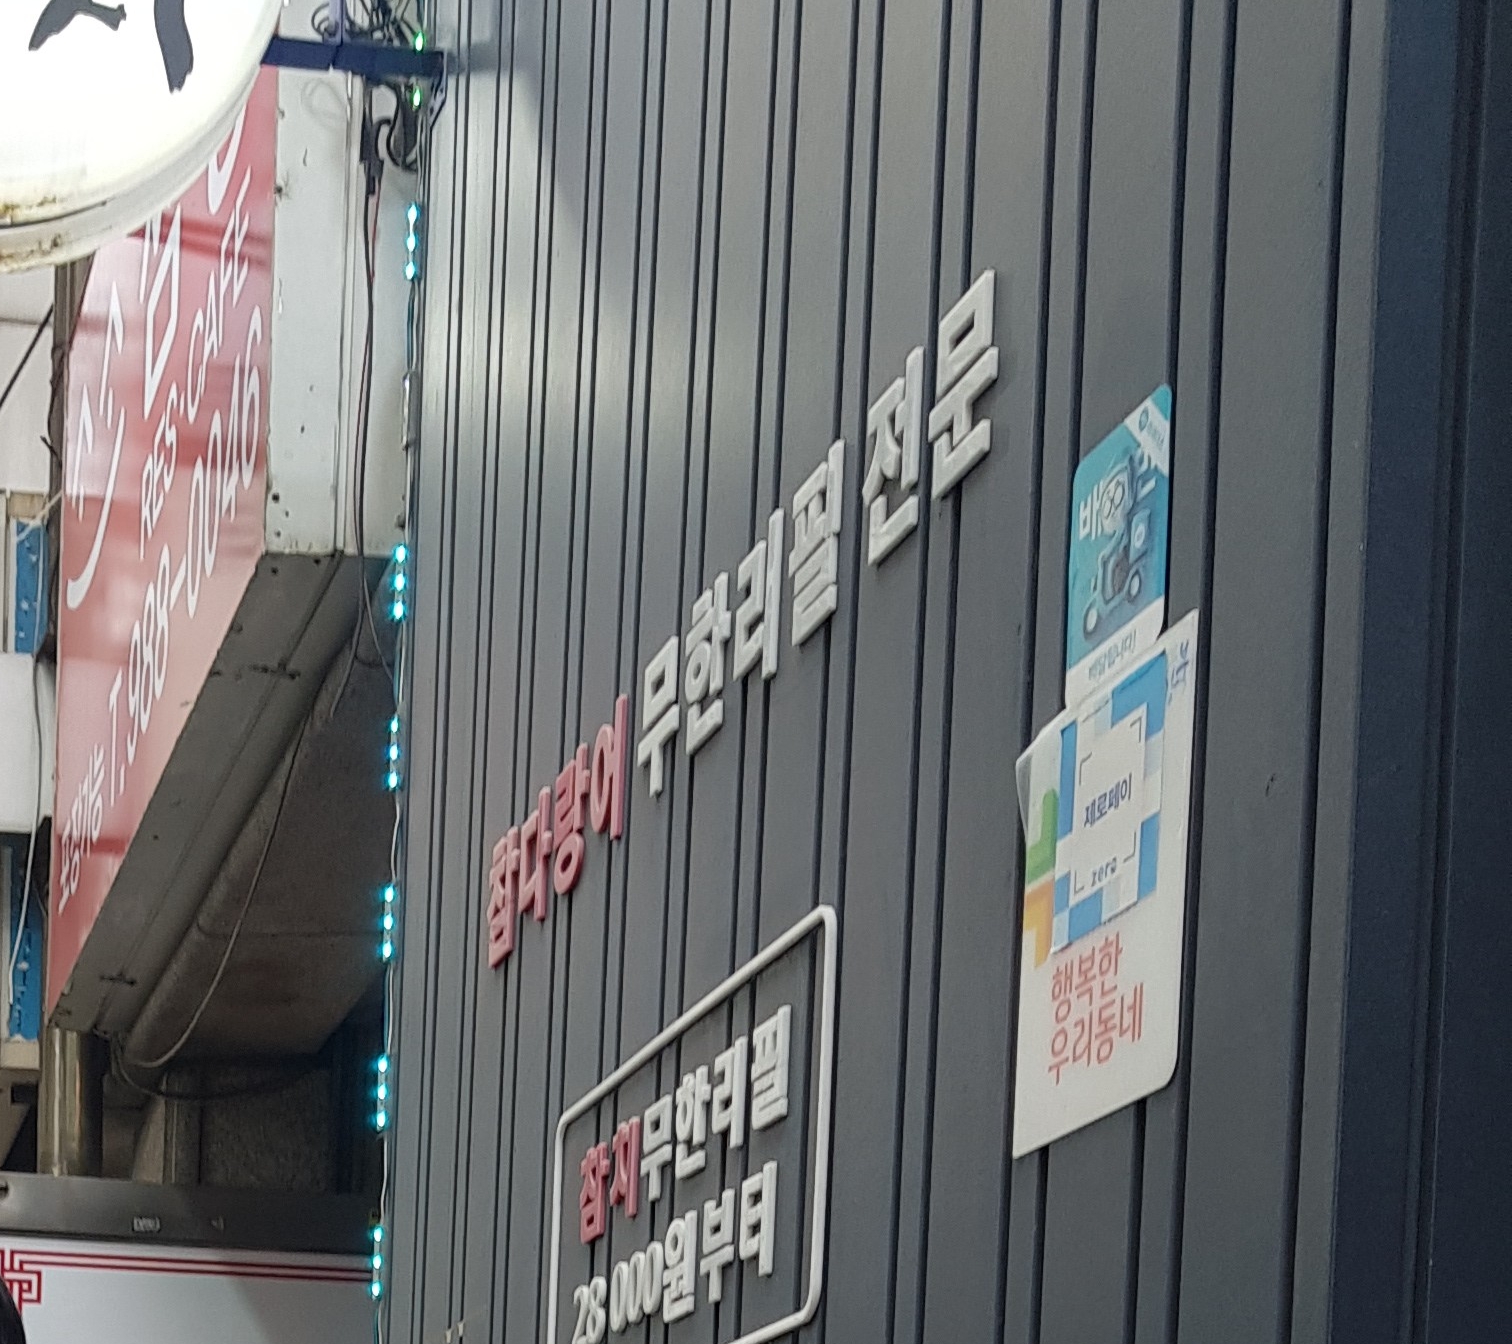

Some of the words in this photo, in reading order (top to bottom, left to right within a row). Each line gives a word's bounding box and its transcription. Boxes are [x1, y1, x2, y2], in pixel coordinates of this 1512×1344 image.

[487, 695, 628, 969] 참다랑어
[637, 439, 846, 797] 무한리필
[862, 268, 999, 566] 전문
[1084, 773, 1132, 828] 제로페이
[1050, 932, 1123, 1024] 행복한
[1048, 982, 1145, 1086] 우리동네
